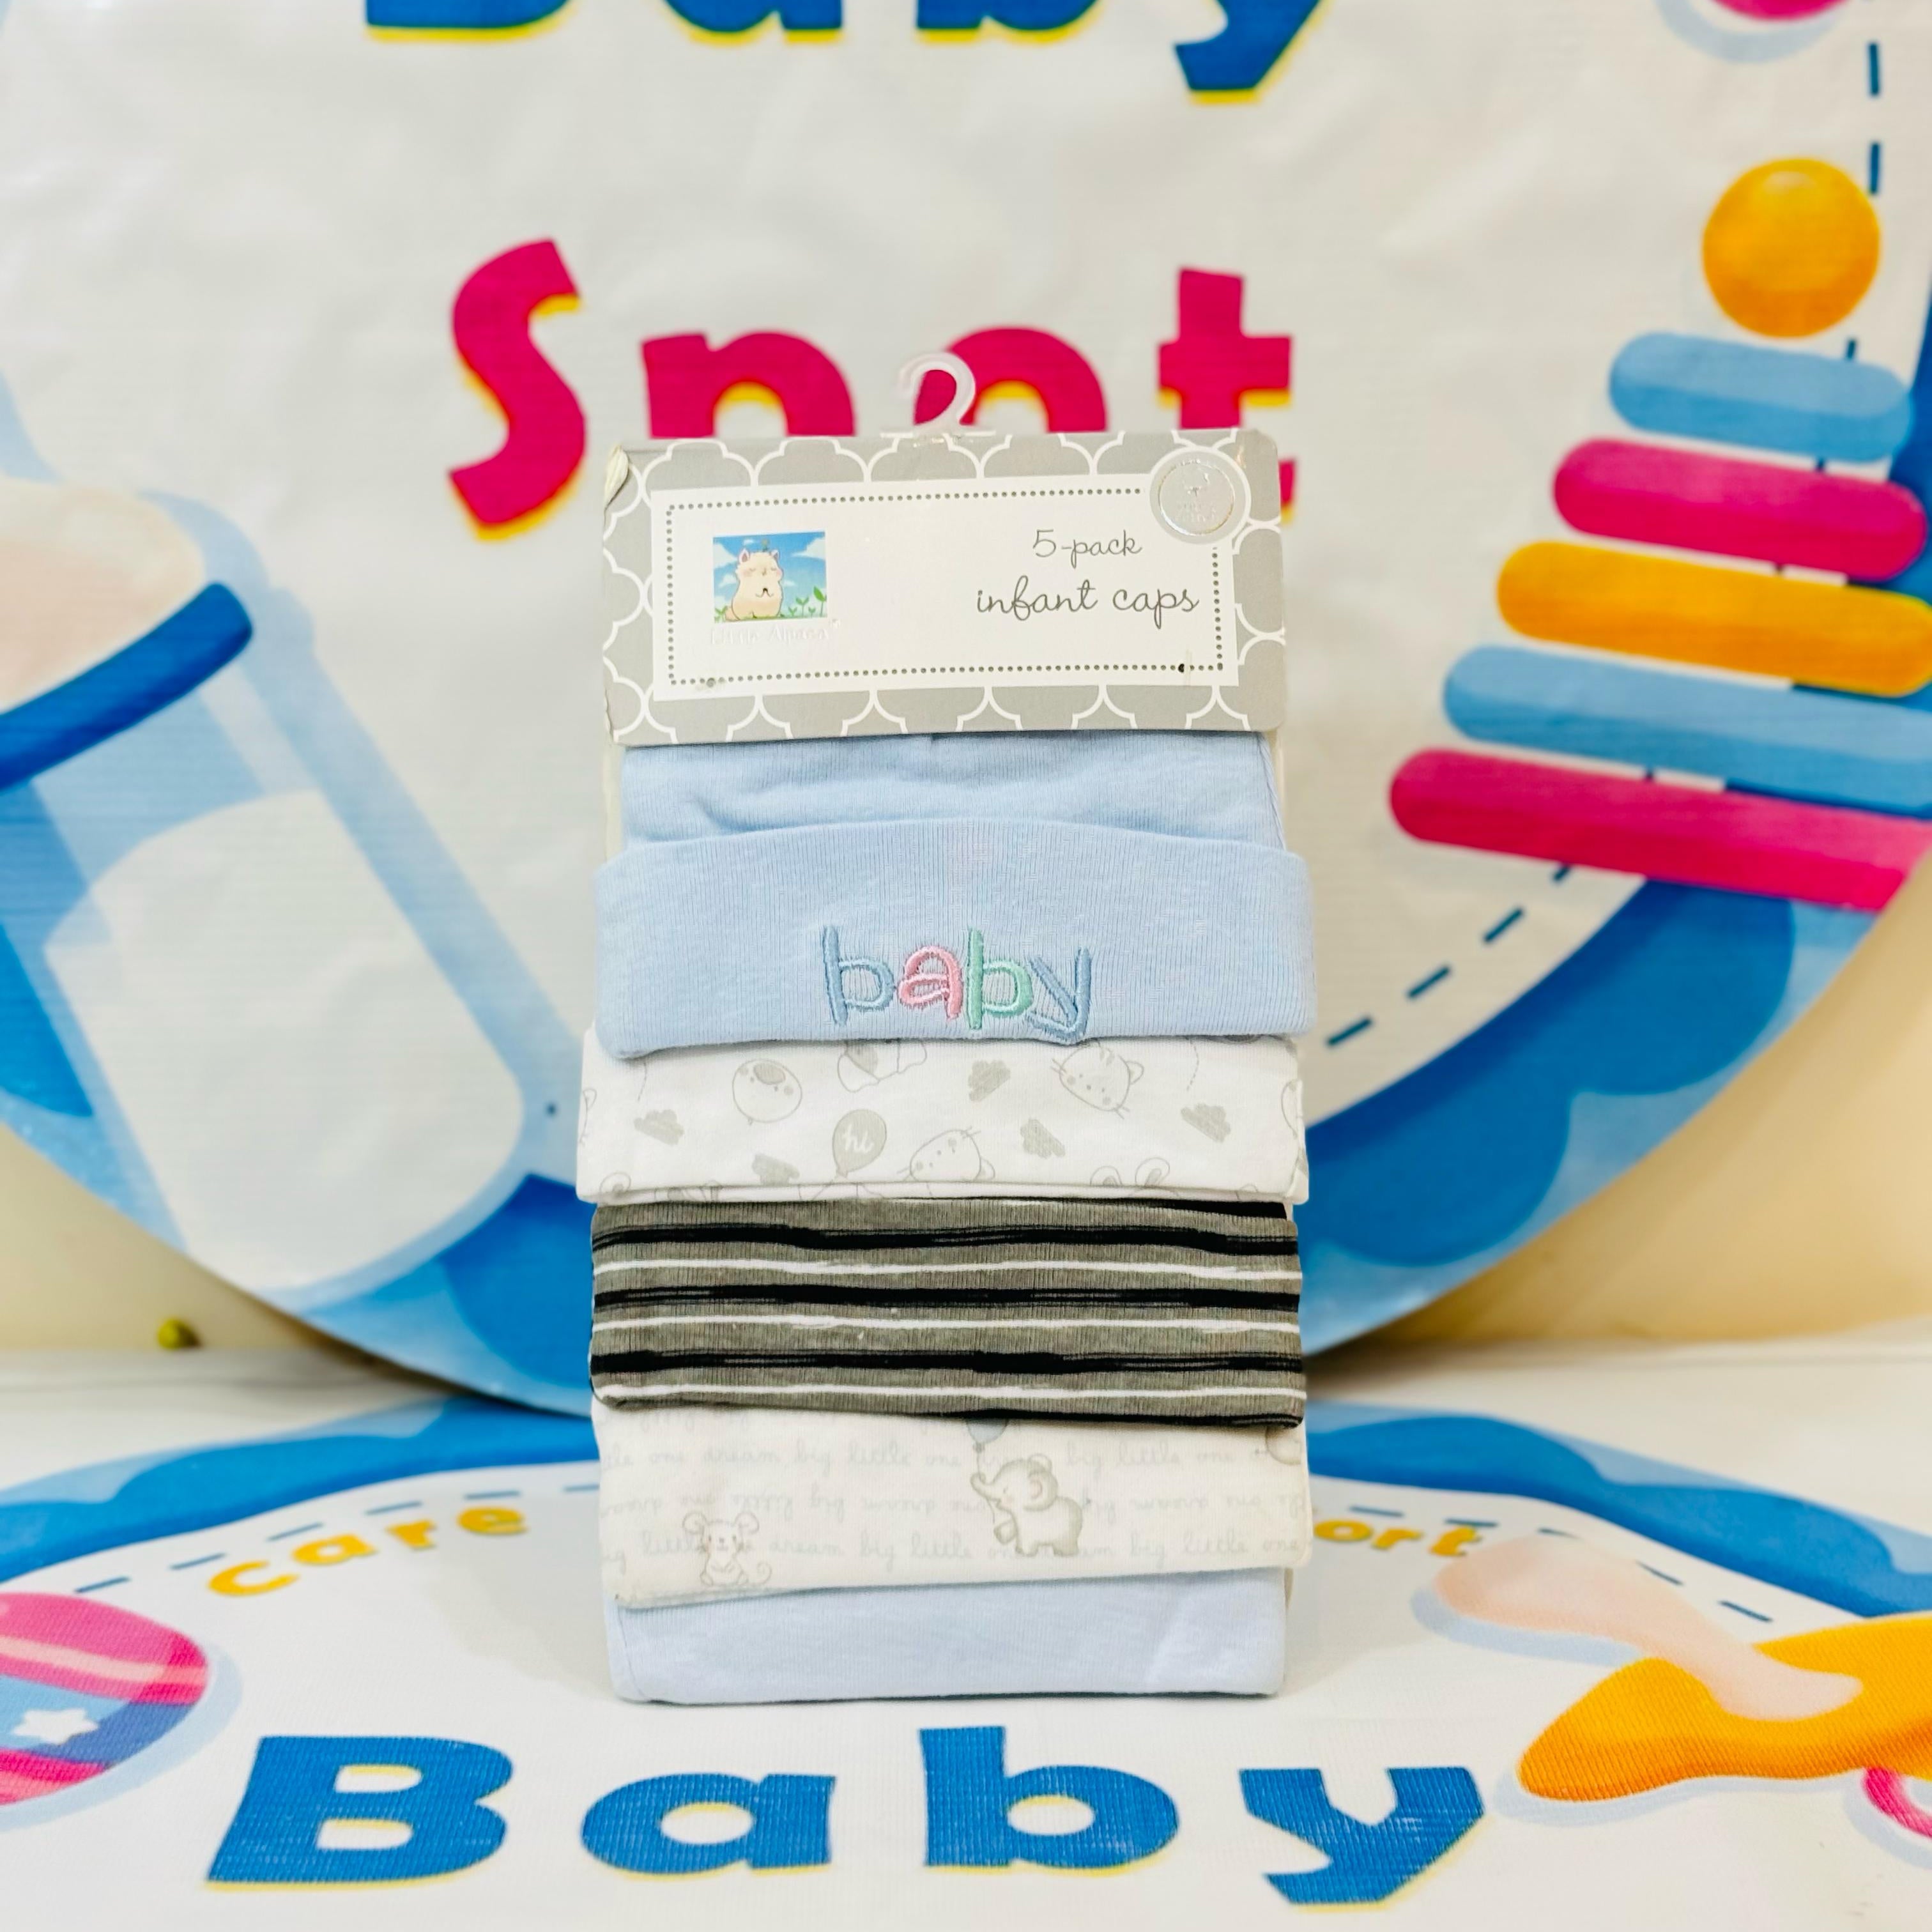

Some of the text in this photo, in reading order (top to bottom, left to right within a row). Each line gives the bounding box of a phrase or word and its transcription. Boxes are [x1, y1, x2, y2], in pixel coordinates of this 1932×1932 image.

[1032, 529, 1142, 569] 5-pack
[977, 575, 1199, 629] infant caps
[823, 925, 1092, 1045] baby
[842, 1123, 875, 1154] hi
[795, 1439, 831, 1476] big
[848, 1440, 912, 1468] little
[208, 1505, 529, 1597] care
[206, 1725, 1486, 1908] Baby
